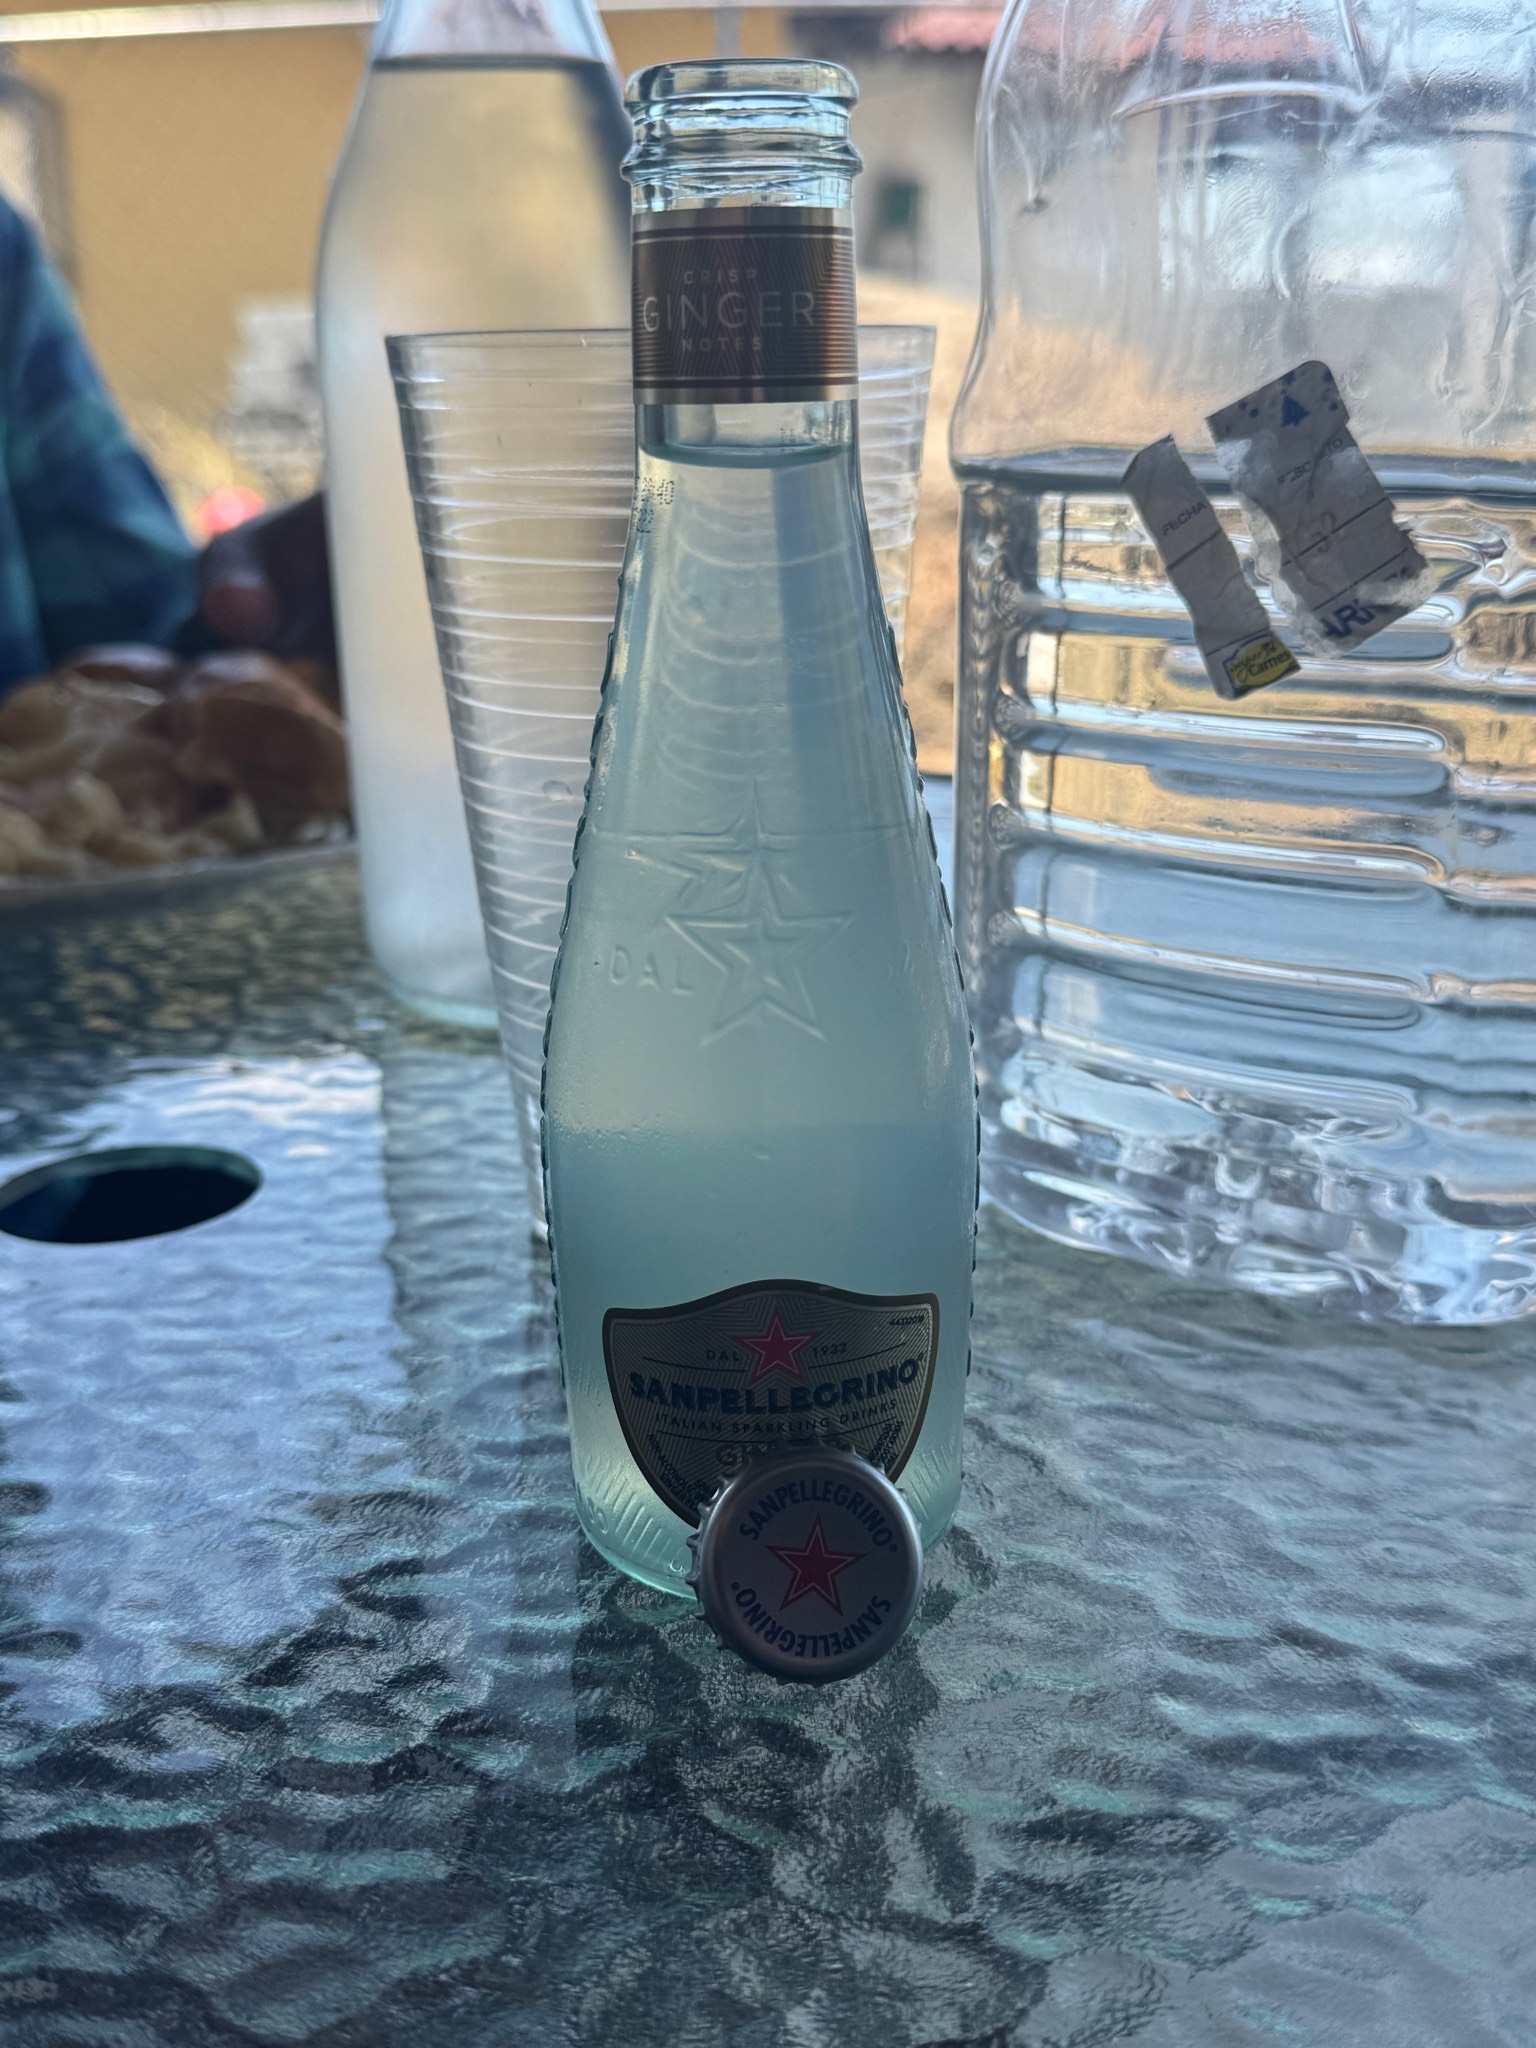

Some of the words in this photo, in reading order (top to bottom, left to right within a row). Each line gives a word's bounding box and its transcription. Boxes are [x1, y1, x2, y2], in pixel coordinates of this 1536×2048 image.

[643, 291, 816, 333] GINGER
[682, 336, 763, 352] NOTES
[1162, 502, 1206, 537] FECHA
[608, 944, 695, 996] DAL
[705, 1349, 743, 1362] DAL
[813, 1342, 848, 1358] 1932
[656, 1412, 722, 1433] ITALIAN
[732, 1418, 830, 1433] SPARKLING
[840, 1399, 897, 1424] DRINKS
